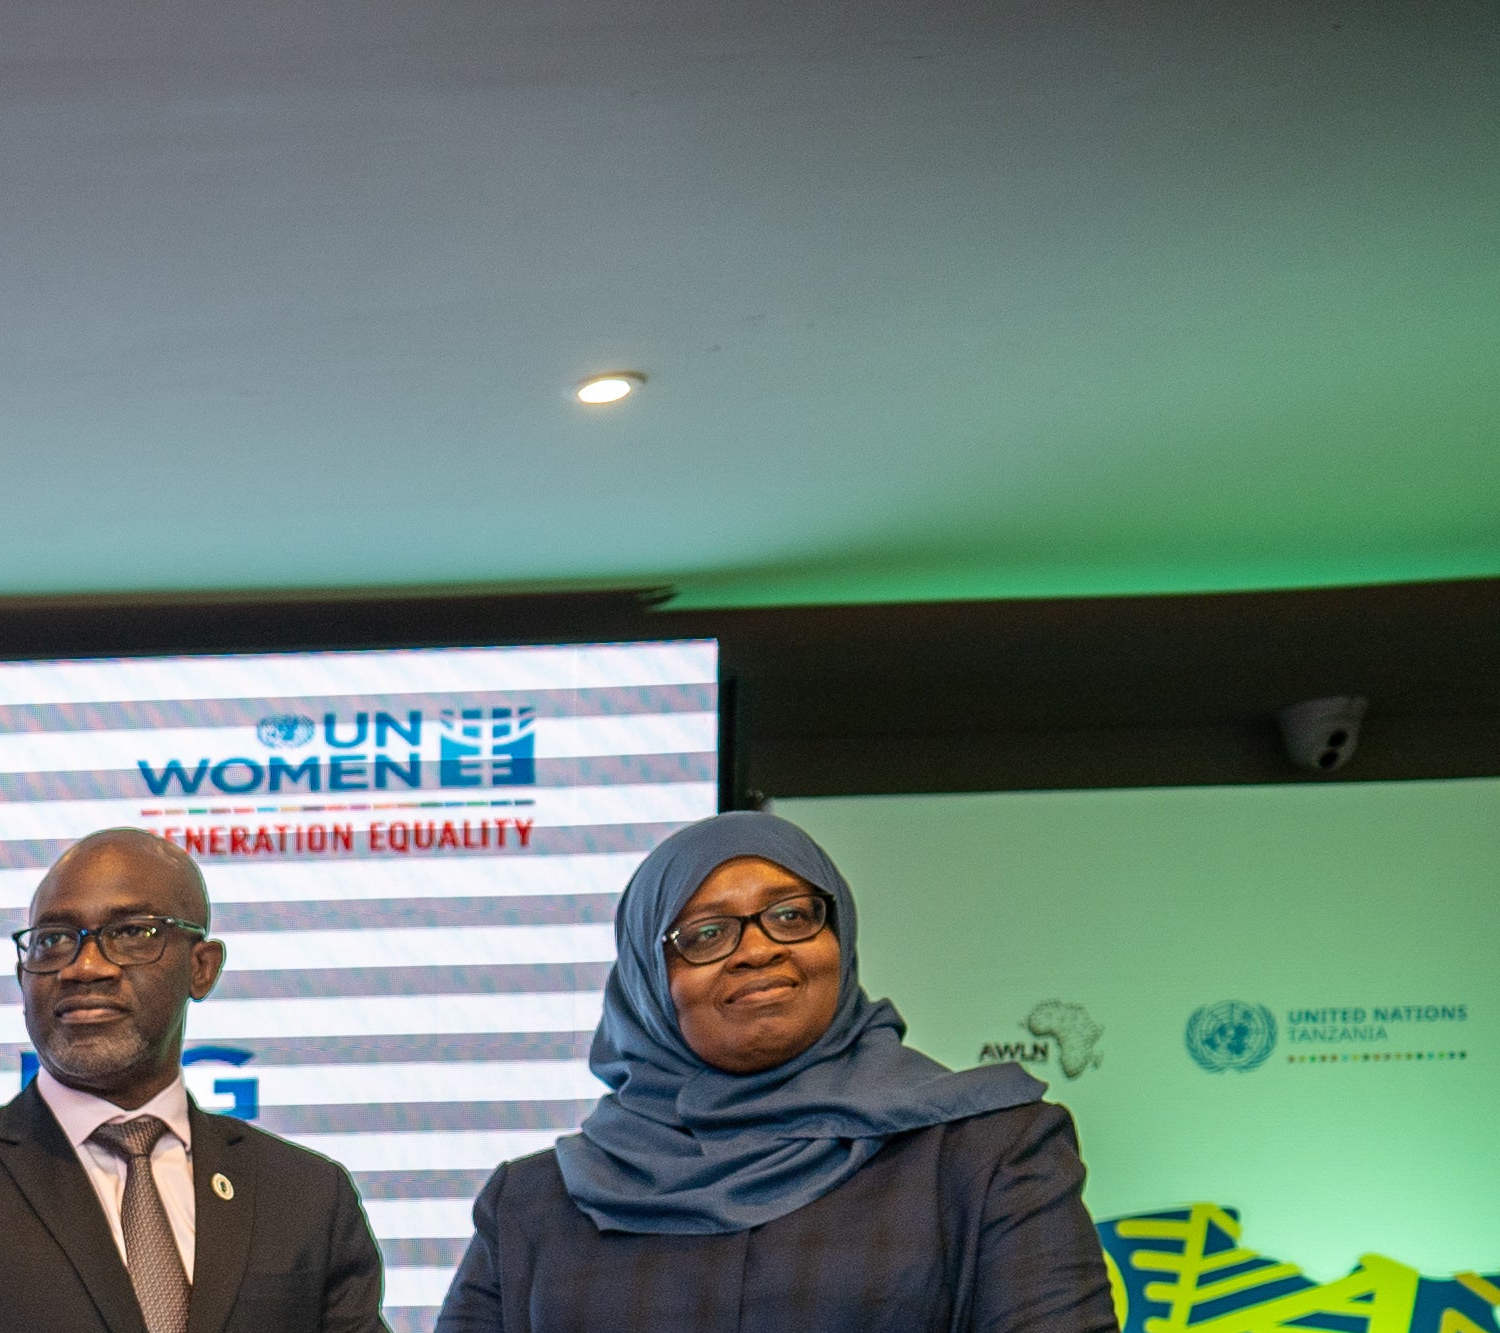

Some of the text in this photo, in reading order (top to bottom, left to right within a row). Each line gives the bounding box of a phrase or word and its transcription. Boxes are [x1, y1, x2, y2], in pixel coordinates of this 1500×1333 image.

[323, 709, 422, 749] UN
[137, 752, 422, 797] WOMEN
[148, 817, 535, 857] ENERATION EQUALITY
[1288, 1004, 1468, 1025] UNITED NATIONS
[1288, 1025, 1389, 1043] TANZANIA
[979, 1042, 1049, 1061] AWLN
